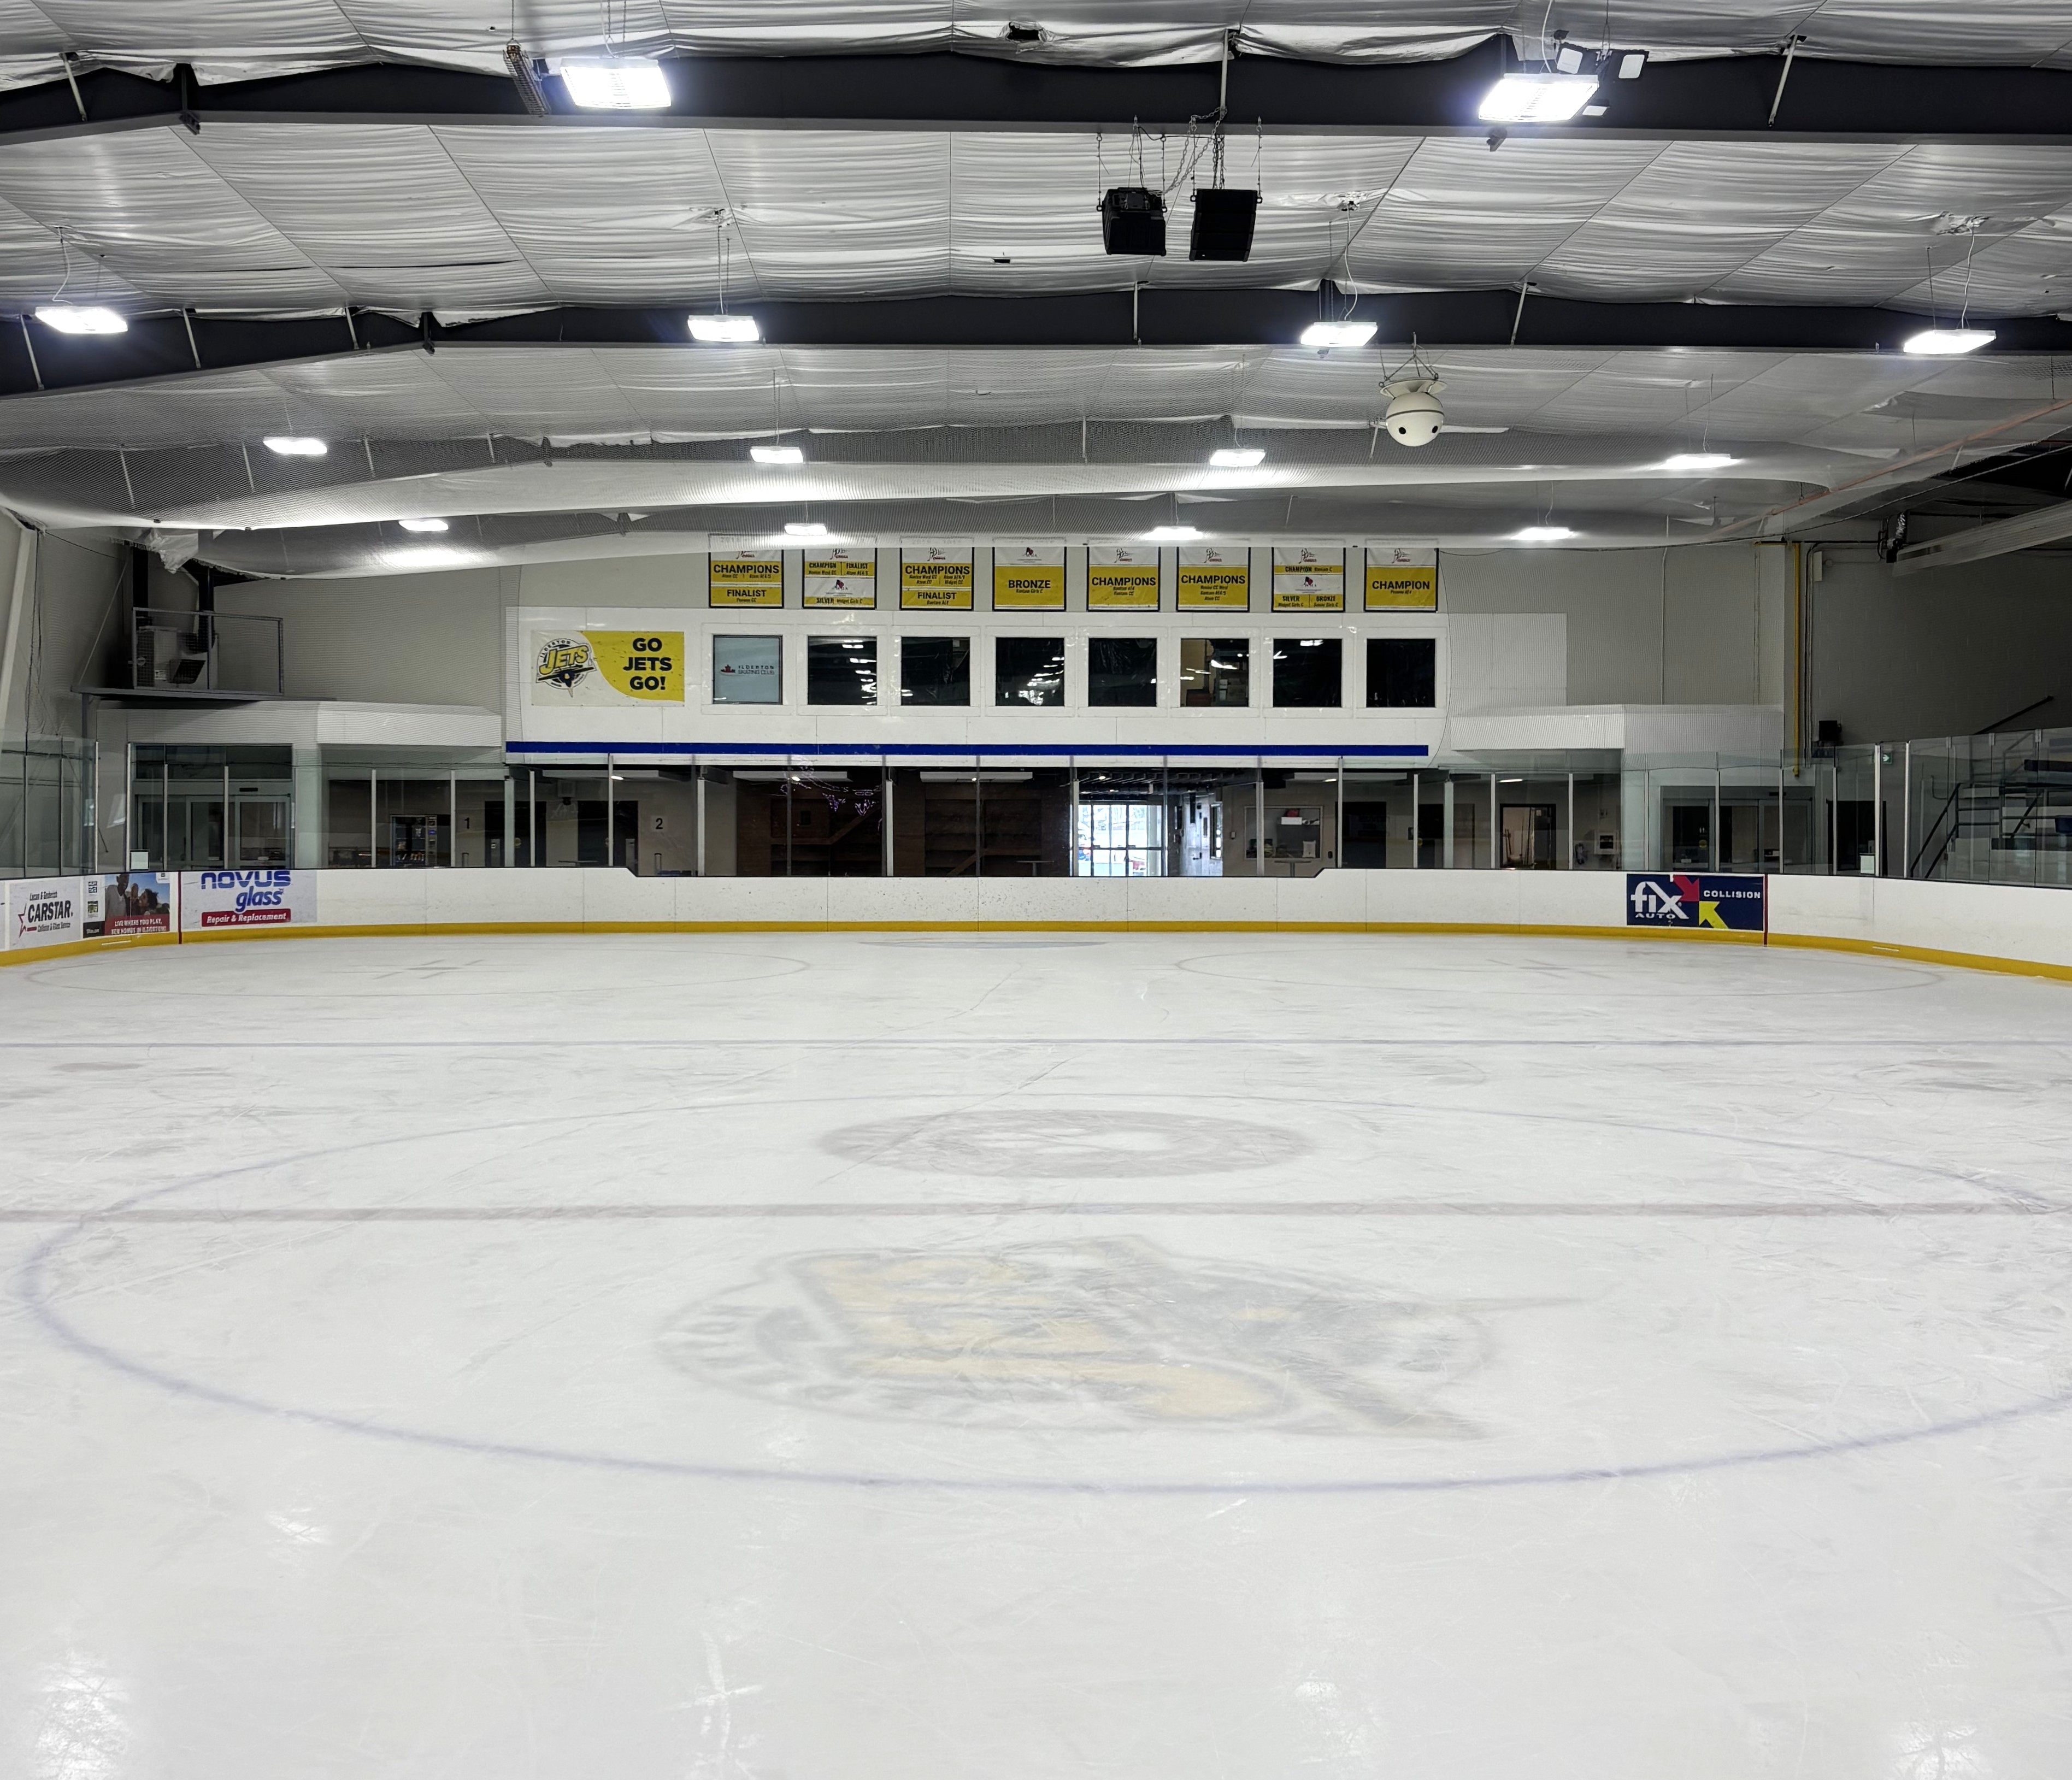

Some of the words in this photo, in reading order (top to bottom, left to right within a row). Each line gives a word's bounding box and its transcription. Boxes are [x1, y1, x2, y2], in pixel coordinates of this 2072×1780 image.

[714, 564, 780, 574] CHAMPIONS
[905, 565, 970, 574] CHAMPIONS
[1008, 580, 1051, 588] BRONZE
[1092, 577, 1156, 586] CHAMPIONS
[1181, 575, 1246, 584] CHAMPIONS
[1372, 581, 1430, 590] CHAMPION
[633, 638, 662, 652] GO
[539, 645, 589, 675] JETS
[623, 657, 672, 671] JETS
[629, 676, 666, 691] GO!
[464, 817, 470, 829] 1
[656, 817, 663, 829] 2
[235, 886, 282, 912] glass
[1630, 881, 1689, 919] fix
[1703, 889, 1761, 899] COLLISION
[207, 915, 230, 925] Repair
[238, 912, 286, 923] Replacement
